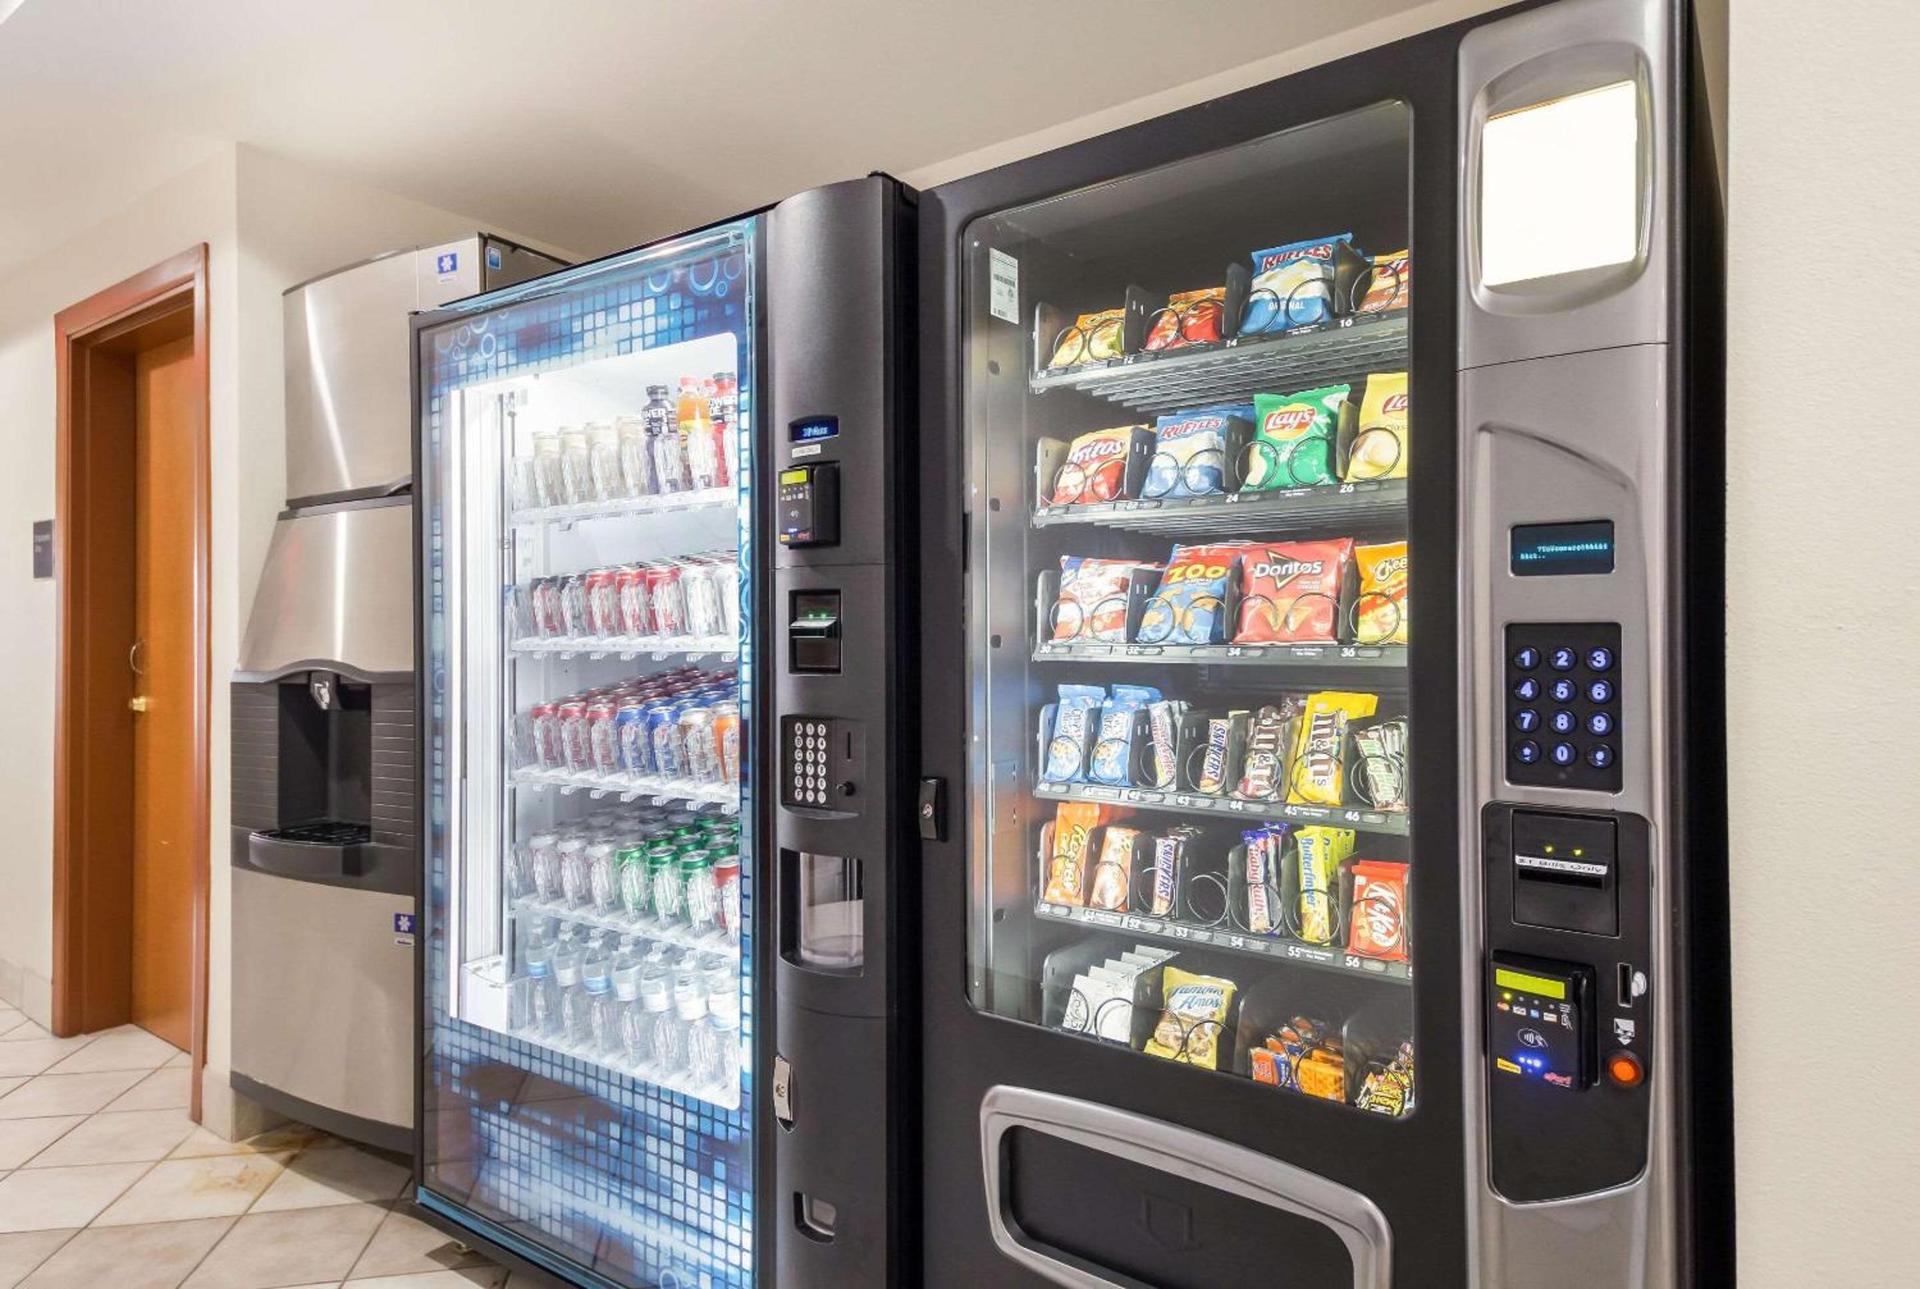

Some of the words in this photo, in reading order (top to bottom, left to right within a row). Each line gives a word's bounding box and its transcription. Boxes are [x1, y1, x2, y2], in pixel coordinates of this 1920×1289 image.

[1261, 244, 1333, 273] RUFFLES
[1339, 483, 1354, 493] 26
[1226, 494, 1239, 503] 24
[1168, 564, 1226, 584] ZOO
[1255, 560, 1324, 578] Doritos
[1228, 647, 1241, 656] 34
[1341, 647, 1355, 657] 36
[1521, 651, 1531, 666] 1
[1557, 651, 1568, 666] 2
[1592, 651, 1606, 667] 3
[1520, 682, 1533, 698] 4
[1557, 683, 1568, 699] 5
[1592, 683, 1606, 700] 6
[1521, 713, 1532, 729] 7
[1557, 714, 1568, 730] 8
[1593, 715, 1607, 732] 9
[1207, 725, 1226, 779] SNICKERS
[1557, 746, 1568, 762] 0
[1345, 811, 1360, 821] 46
[1157, 842, 1174, 897] SNICKERS
[1231, 936, 1243, 947] 54
[1288, 945, 1300, 957] 55
[1345, 956, 1360, 967] 56
